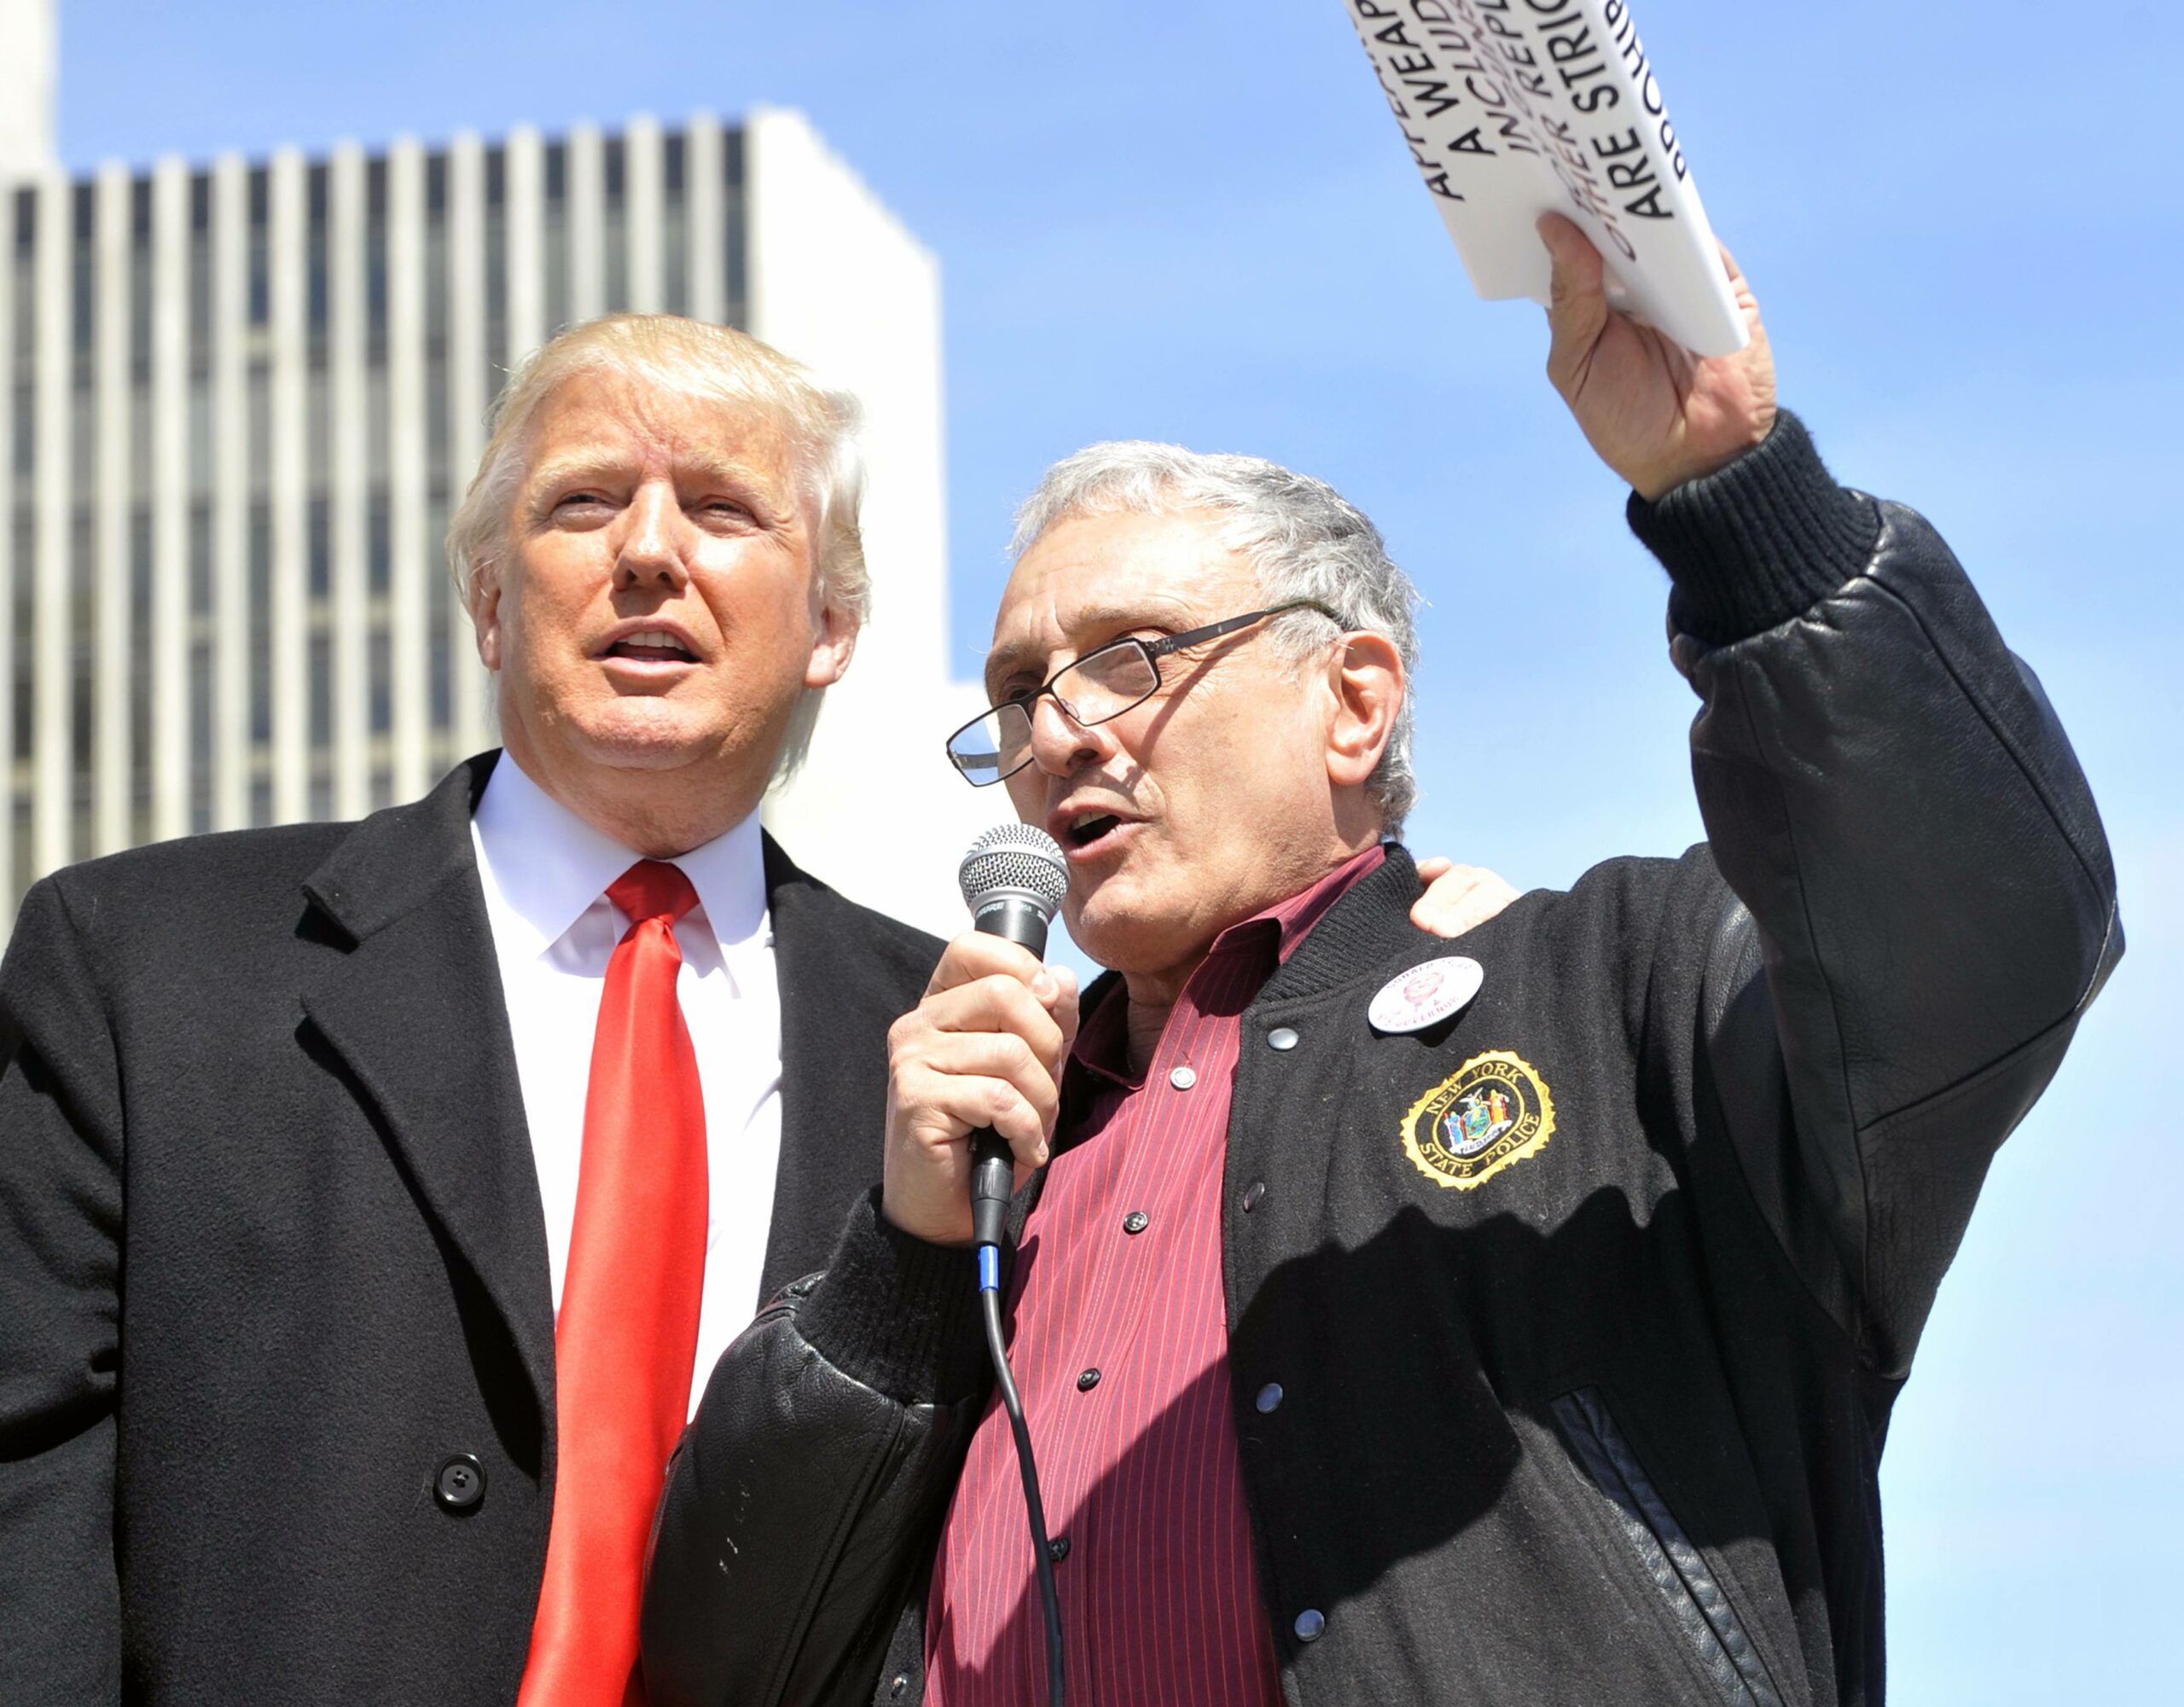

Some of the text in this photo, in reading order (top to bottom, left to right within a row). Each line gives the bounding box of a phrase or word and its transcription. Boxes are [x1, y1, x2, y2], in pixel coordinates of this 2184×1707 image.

[1447, 126, 1498, 157] A
[1591, 126, 1675, 219] ARE
[1540, 113, 1637, 262] OTHER
[1426, 1062, 1525, 1114] NEW YORK
[1420, 1141, 1473, 1178] STATE
[1486, 1112, 1540, 1166] POLICE
